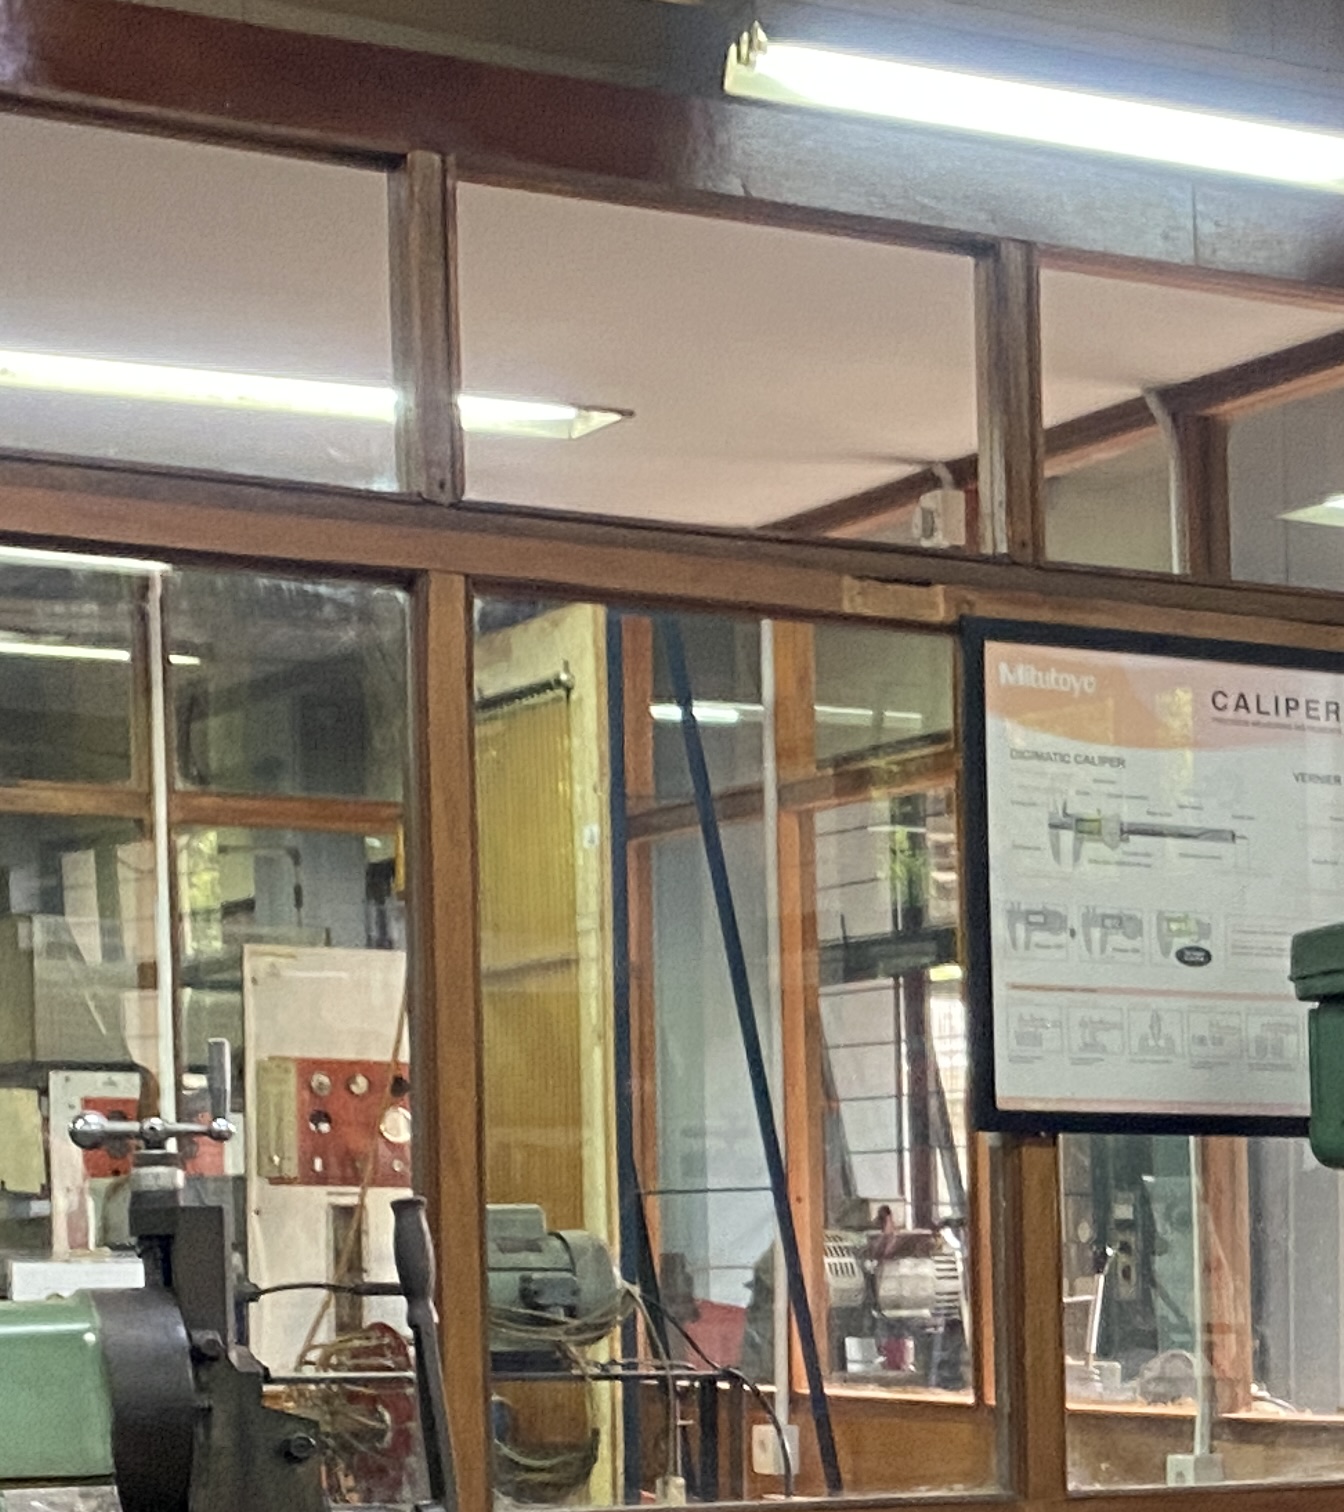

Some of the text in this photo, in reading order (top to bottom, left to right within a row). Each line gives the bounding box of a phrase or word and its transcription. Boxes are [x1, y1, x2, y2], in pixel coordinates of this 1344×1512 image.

[1210, 690, 1342, 723] CALIPER
[1073, 753, 1126, 770] CALIPER
[1293, 771, 1342, 787] VERNIER
